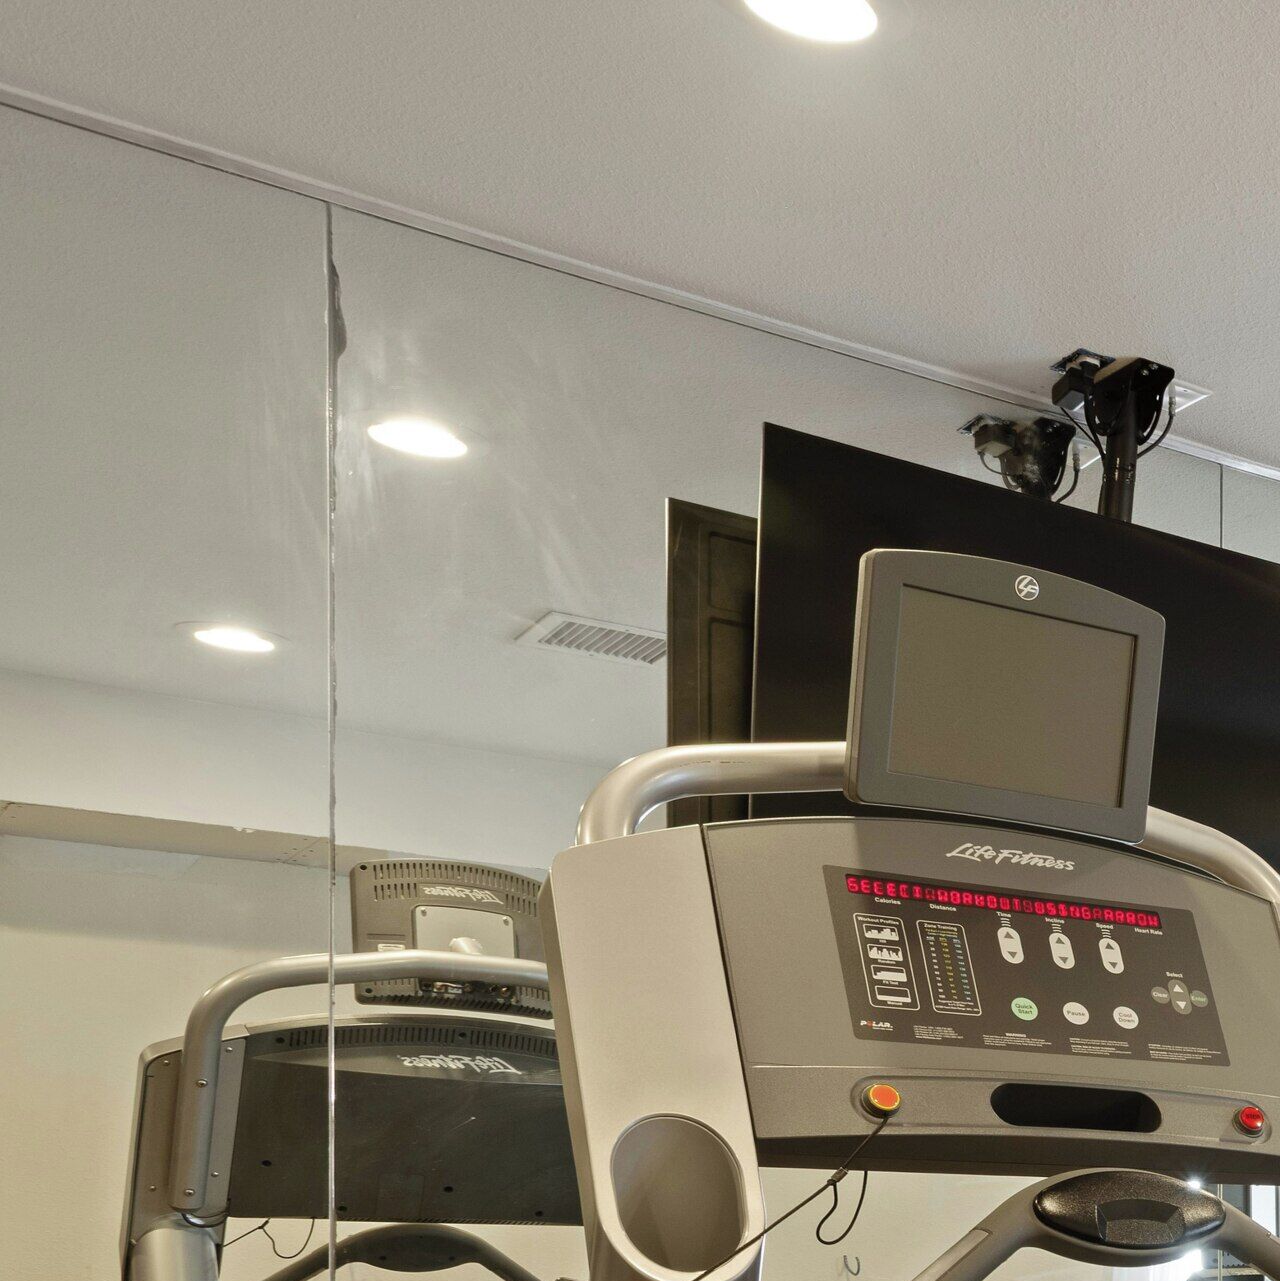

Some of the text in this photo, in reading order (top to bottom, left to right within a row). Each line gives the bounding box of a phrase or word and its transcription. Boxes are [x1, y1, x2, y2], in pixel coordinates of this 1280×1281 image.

[946, 843, 1076, 871] Life Fitness
[874, 896, 901, 905] Calories
[930, 903, 957, 912] Distance
[1044, 916, 1065, 924] Incline
[1096, 922, 1114, 930] Speed
[1150, 928, 1163, 936] Rate
